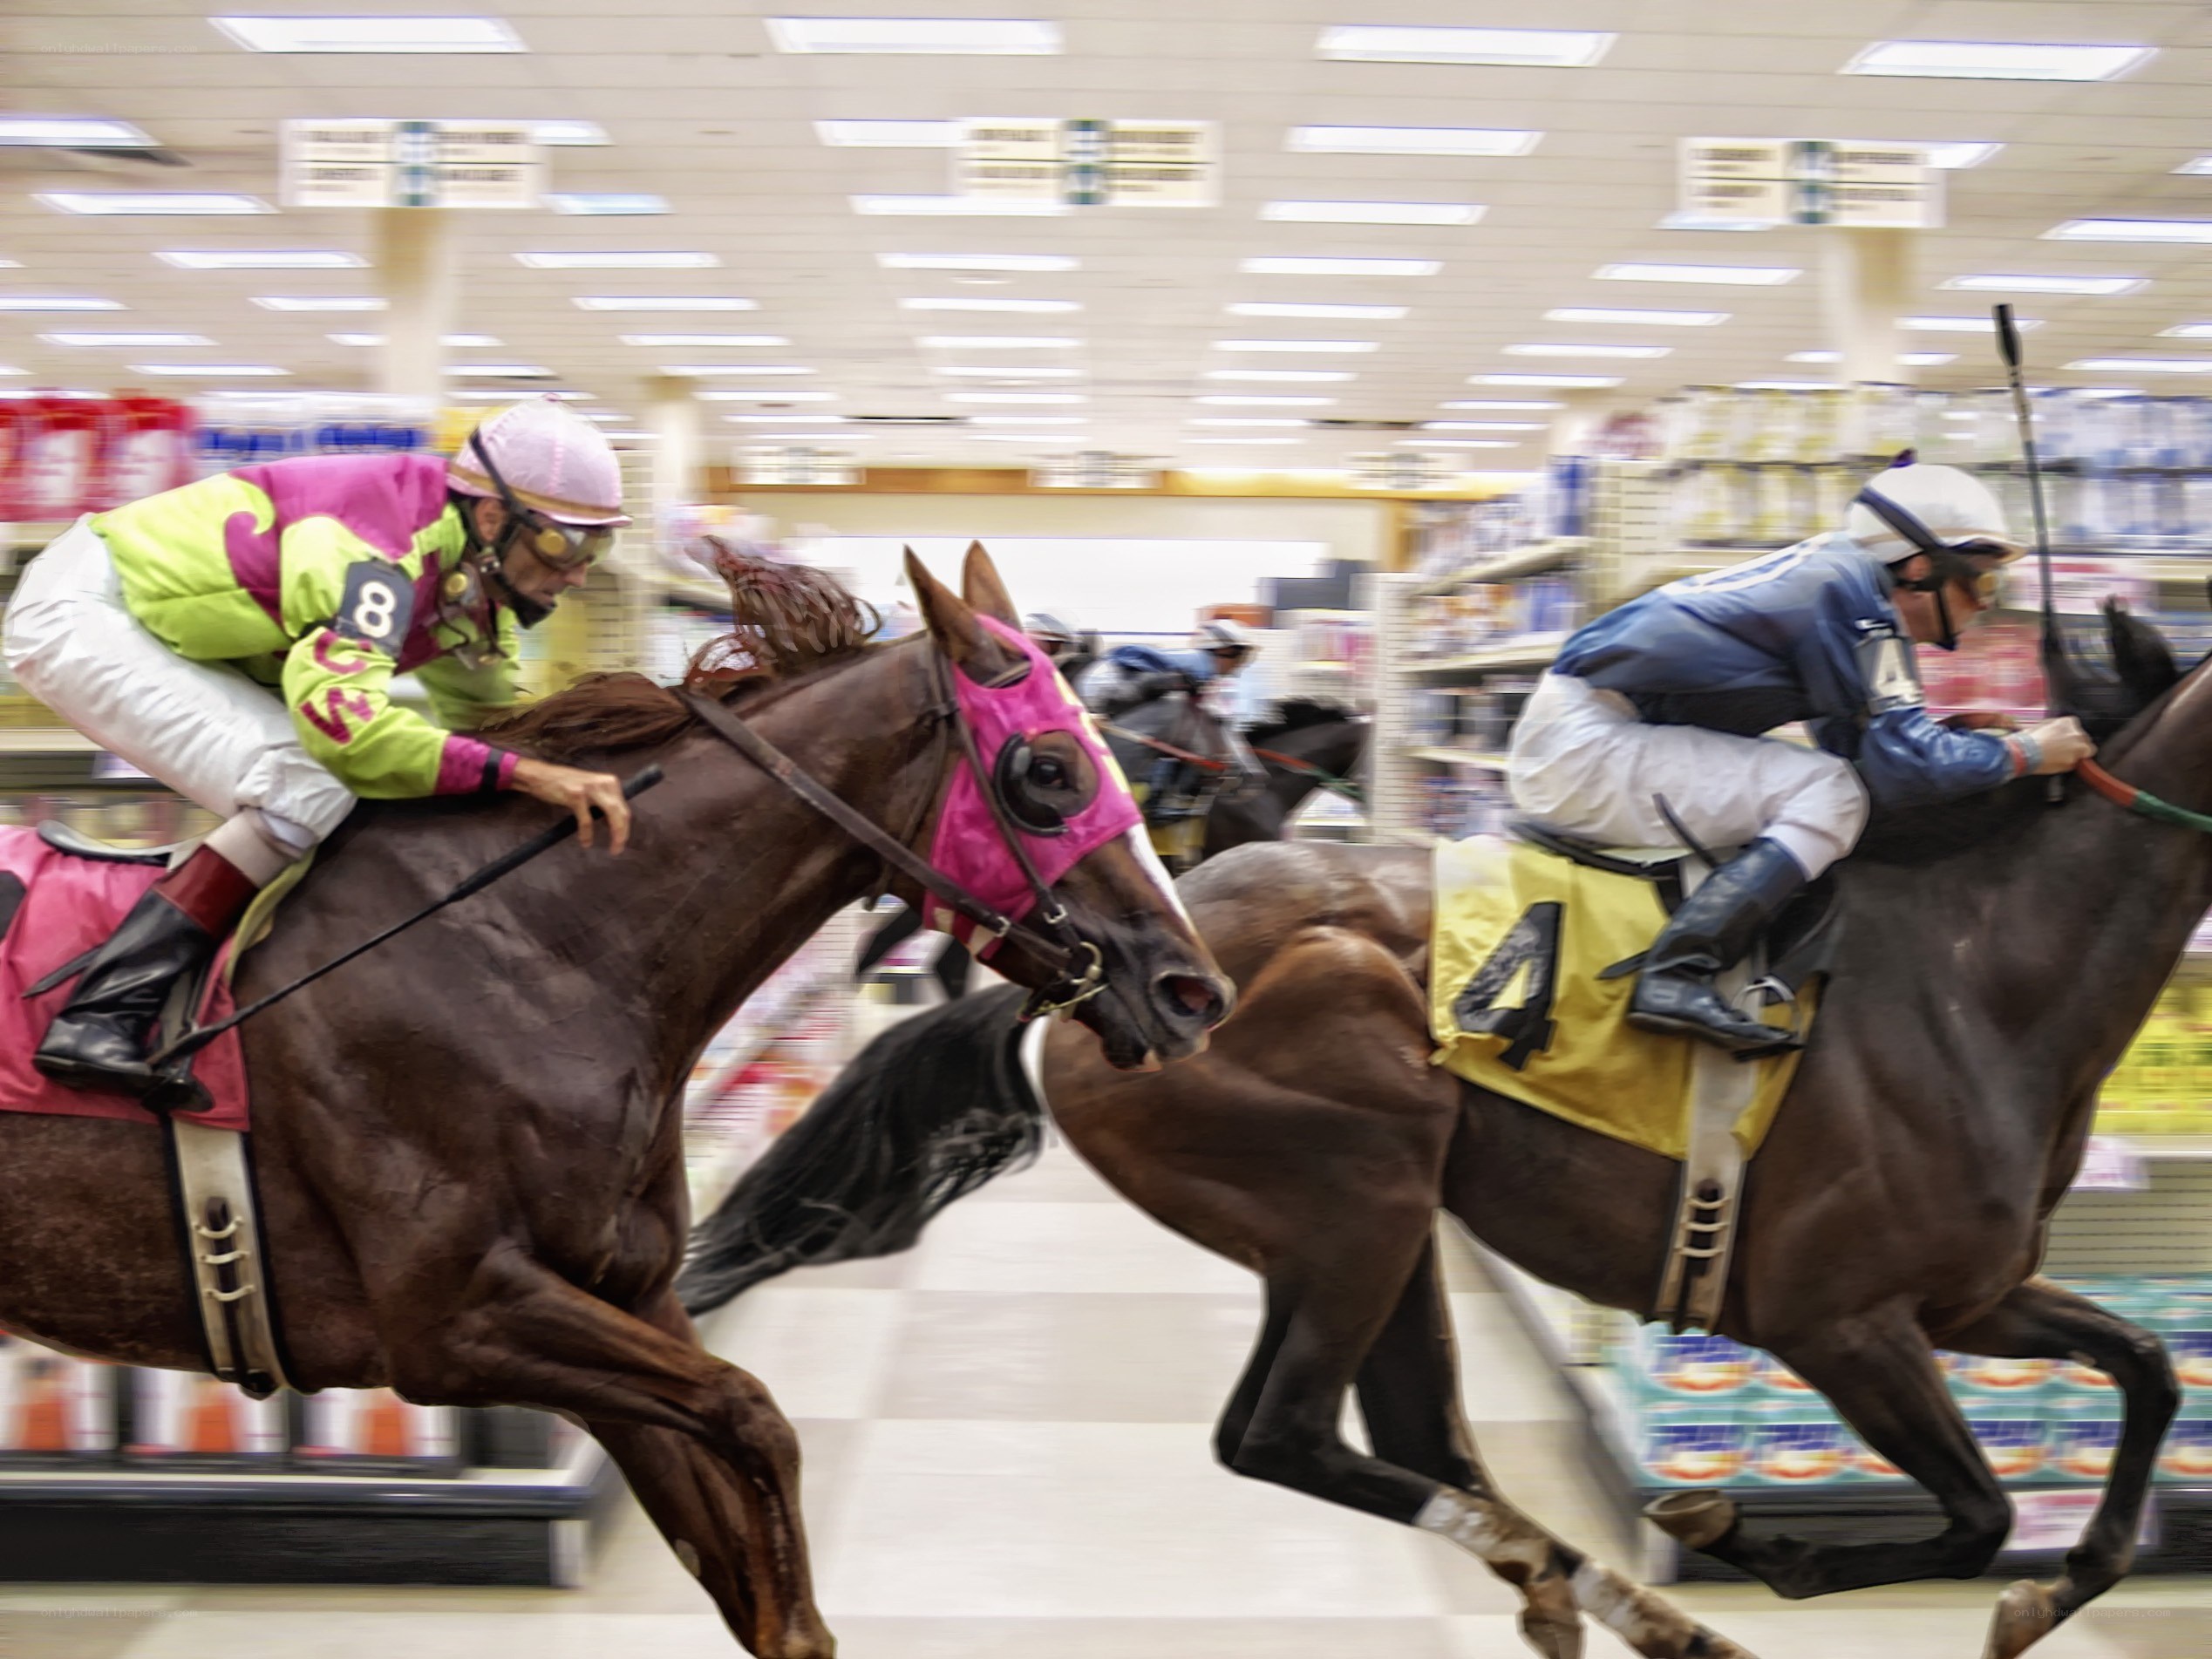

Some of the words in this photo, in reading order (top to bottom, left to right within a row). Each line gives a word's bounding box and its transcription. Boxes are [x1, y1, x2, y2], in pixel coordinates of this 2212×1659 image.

[353, 581, 397, 638] 8
[1874, 637, 1923, 704] 4
[299, 687, 375, 745] W
[1454, 901, 1562, 1071] 4
